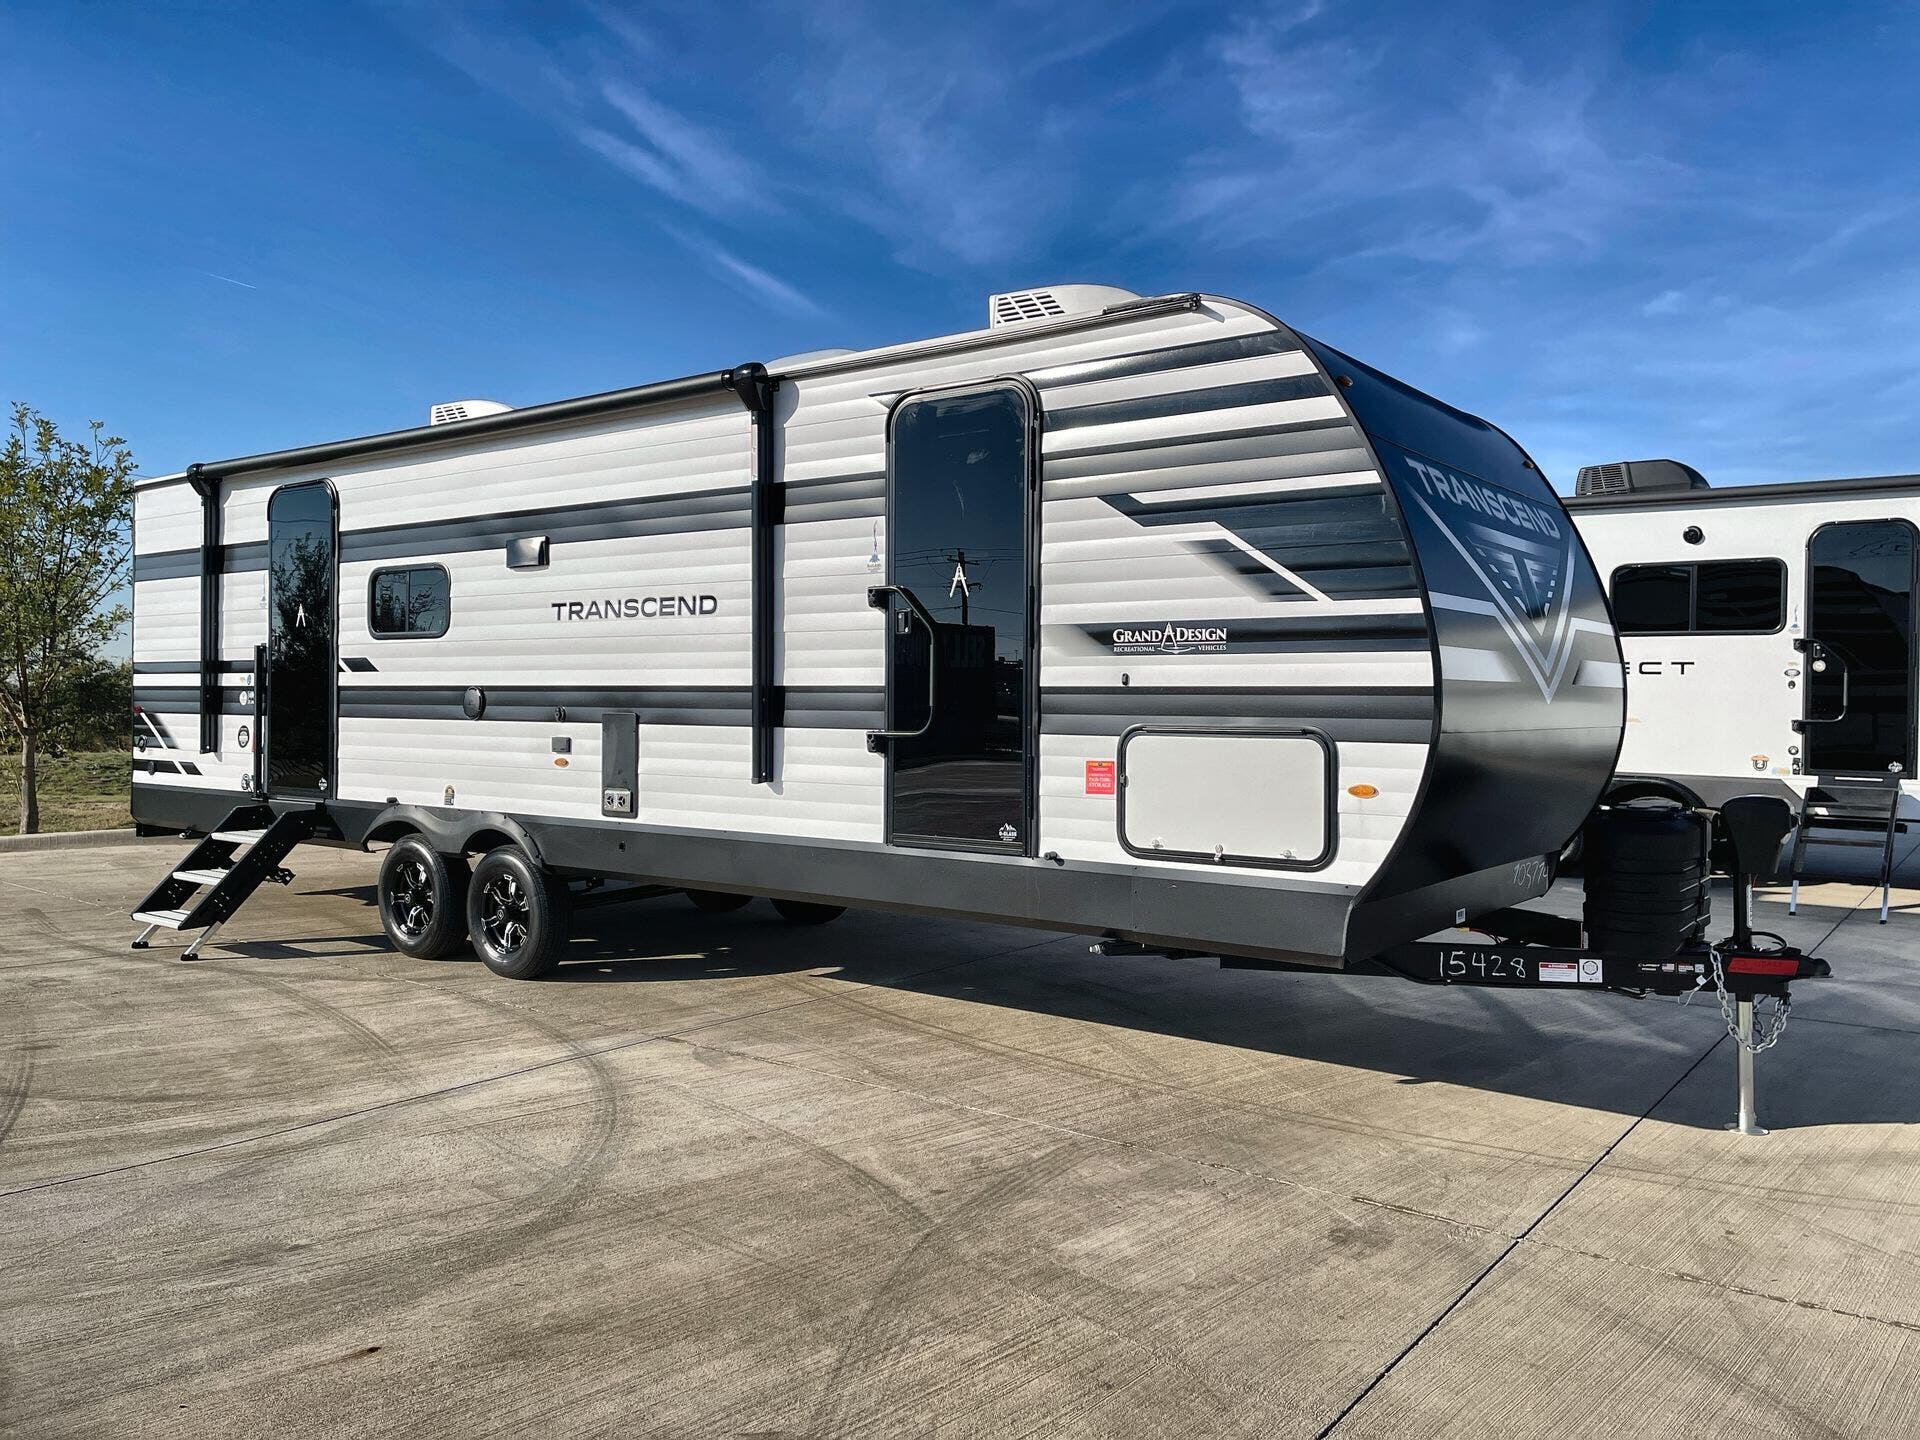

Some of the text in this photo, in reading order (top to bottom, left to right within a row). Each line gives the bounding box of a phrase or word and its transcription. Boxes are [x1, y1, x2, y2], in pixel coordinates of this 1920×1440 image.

[1404, 456, 1561, 539] TRANSCEND
[551, 594, 718, 621] TRANSCEND
[1112, 627, 1228, 643] GRAND DESIGN
[1113, 645, 1156, 653] RECREATIONAL
[1440, 951, 1526, 978] 15428
